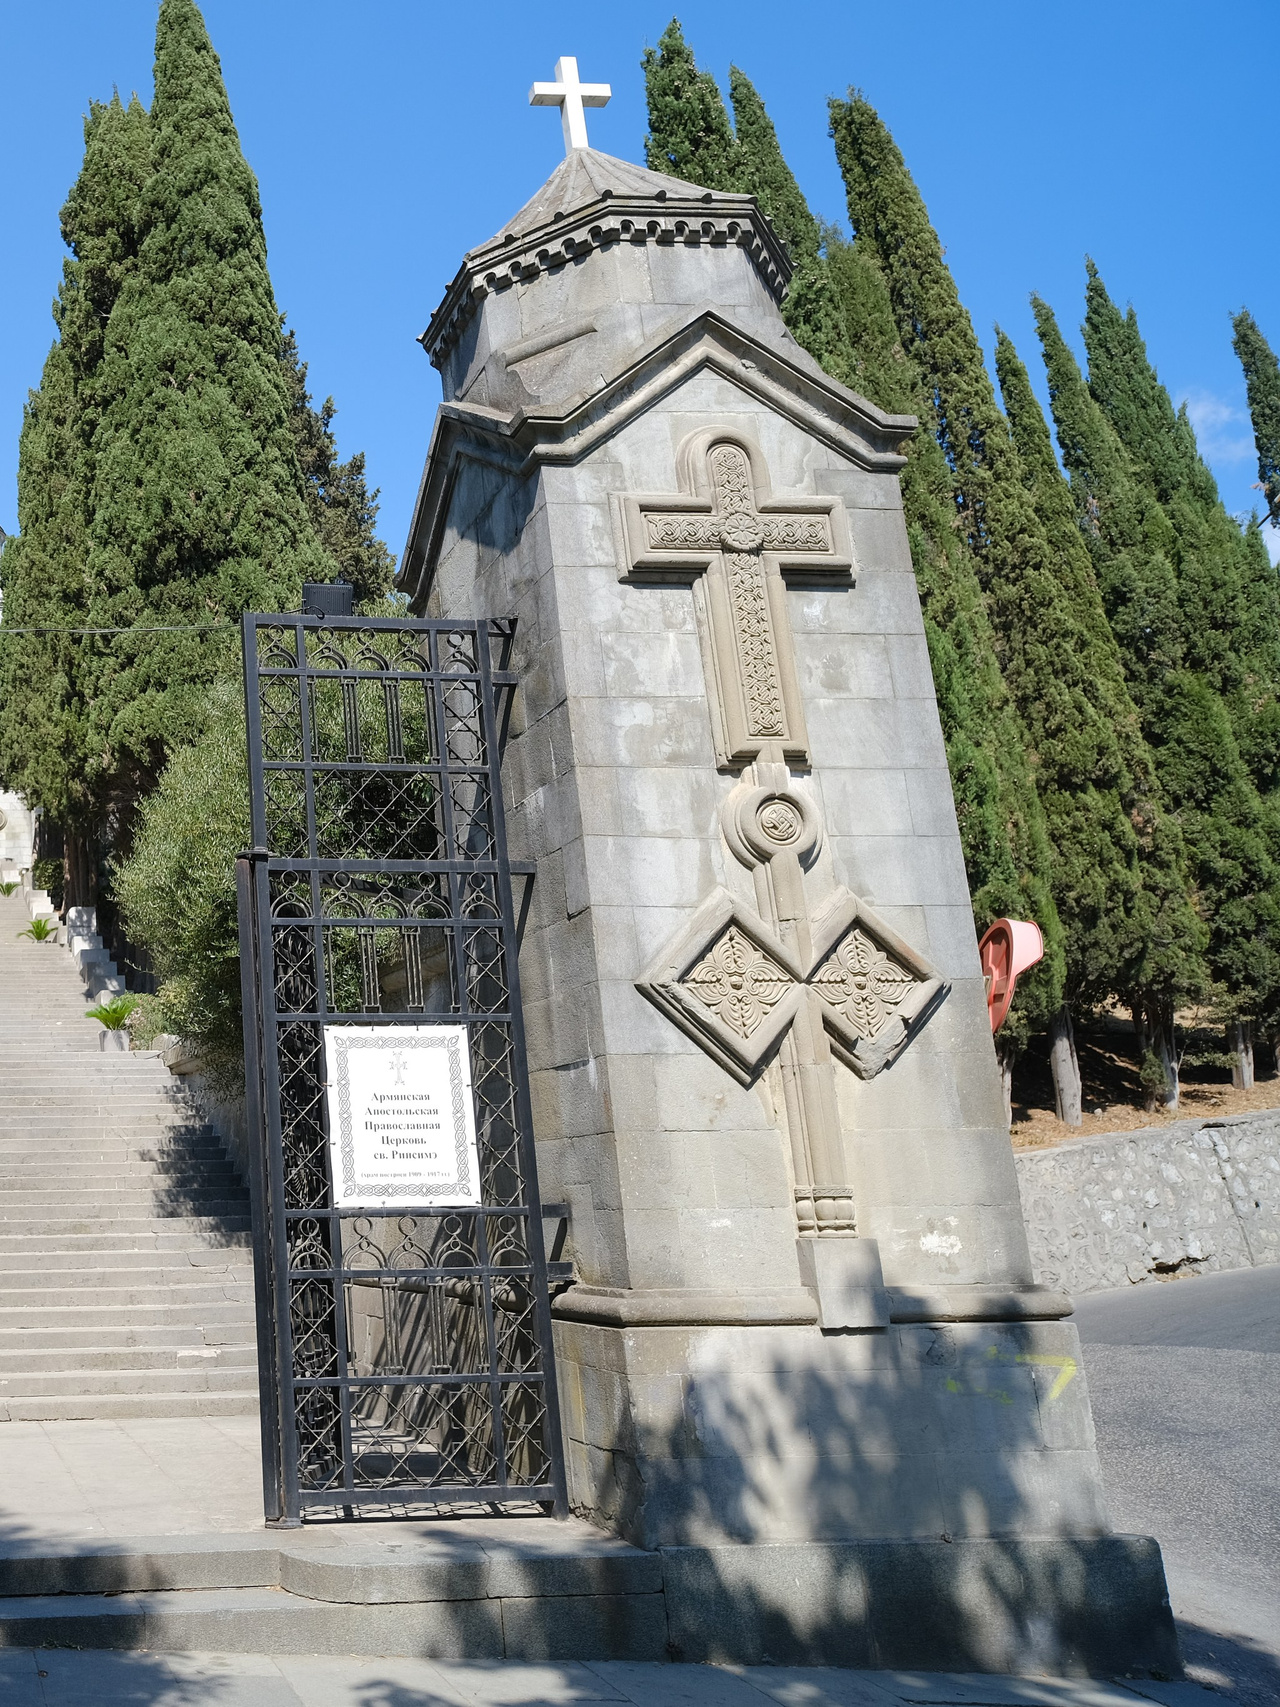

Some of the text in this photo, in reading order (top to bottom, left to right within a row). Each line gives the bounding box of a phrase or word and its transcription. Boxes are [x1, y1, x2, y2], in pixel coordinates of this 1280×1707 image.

[371, 1092, 431, 1103] Армянская
[364, 1106, 439, 1116] Апостольская
[364, 1121, 441, 1132] Православная
[381, 1135, 427, 1147] Церковь
[373, 1149, 438, 1160] св. Рипсимэ
